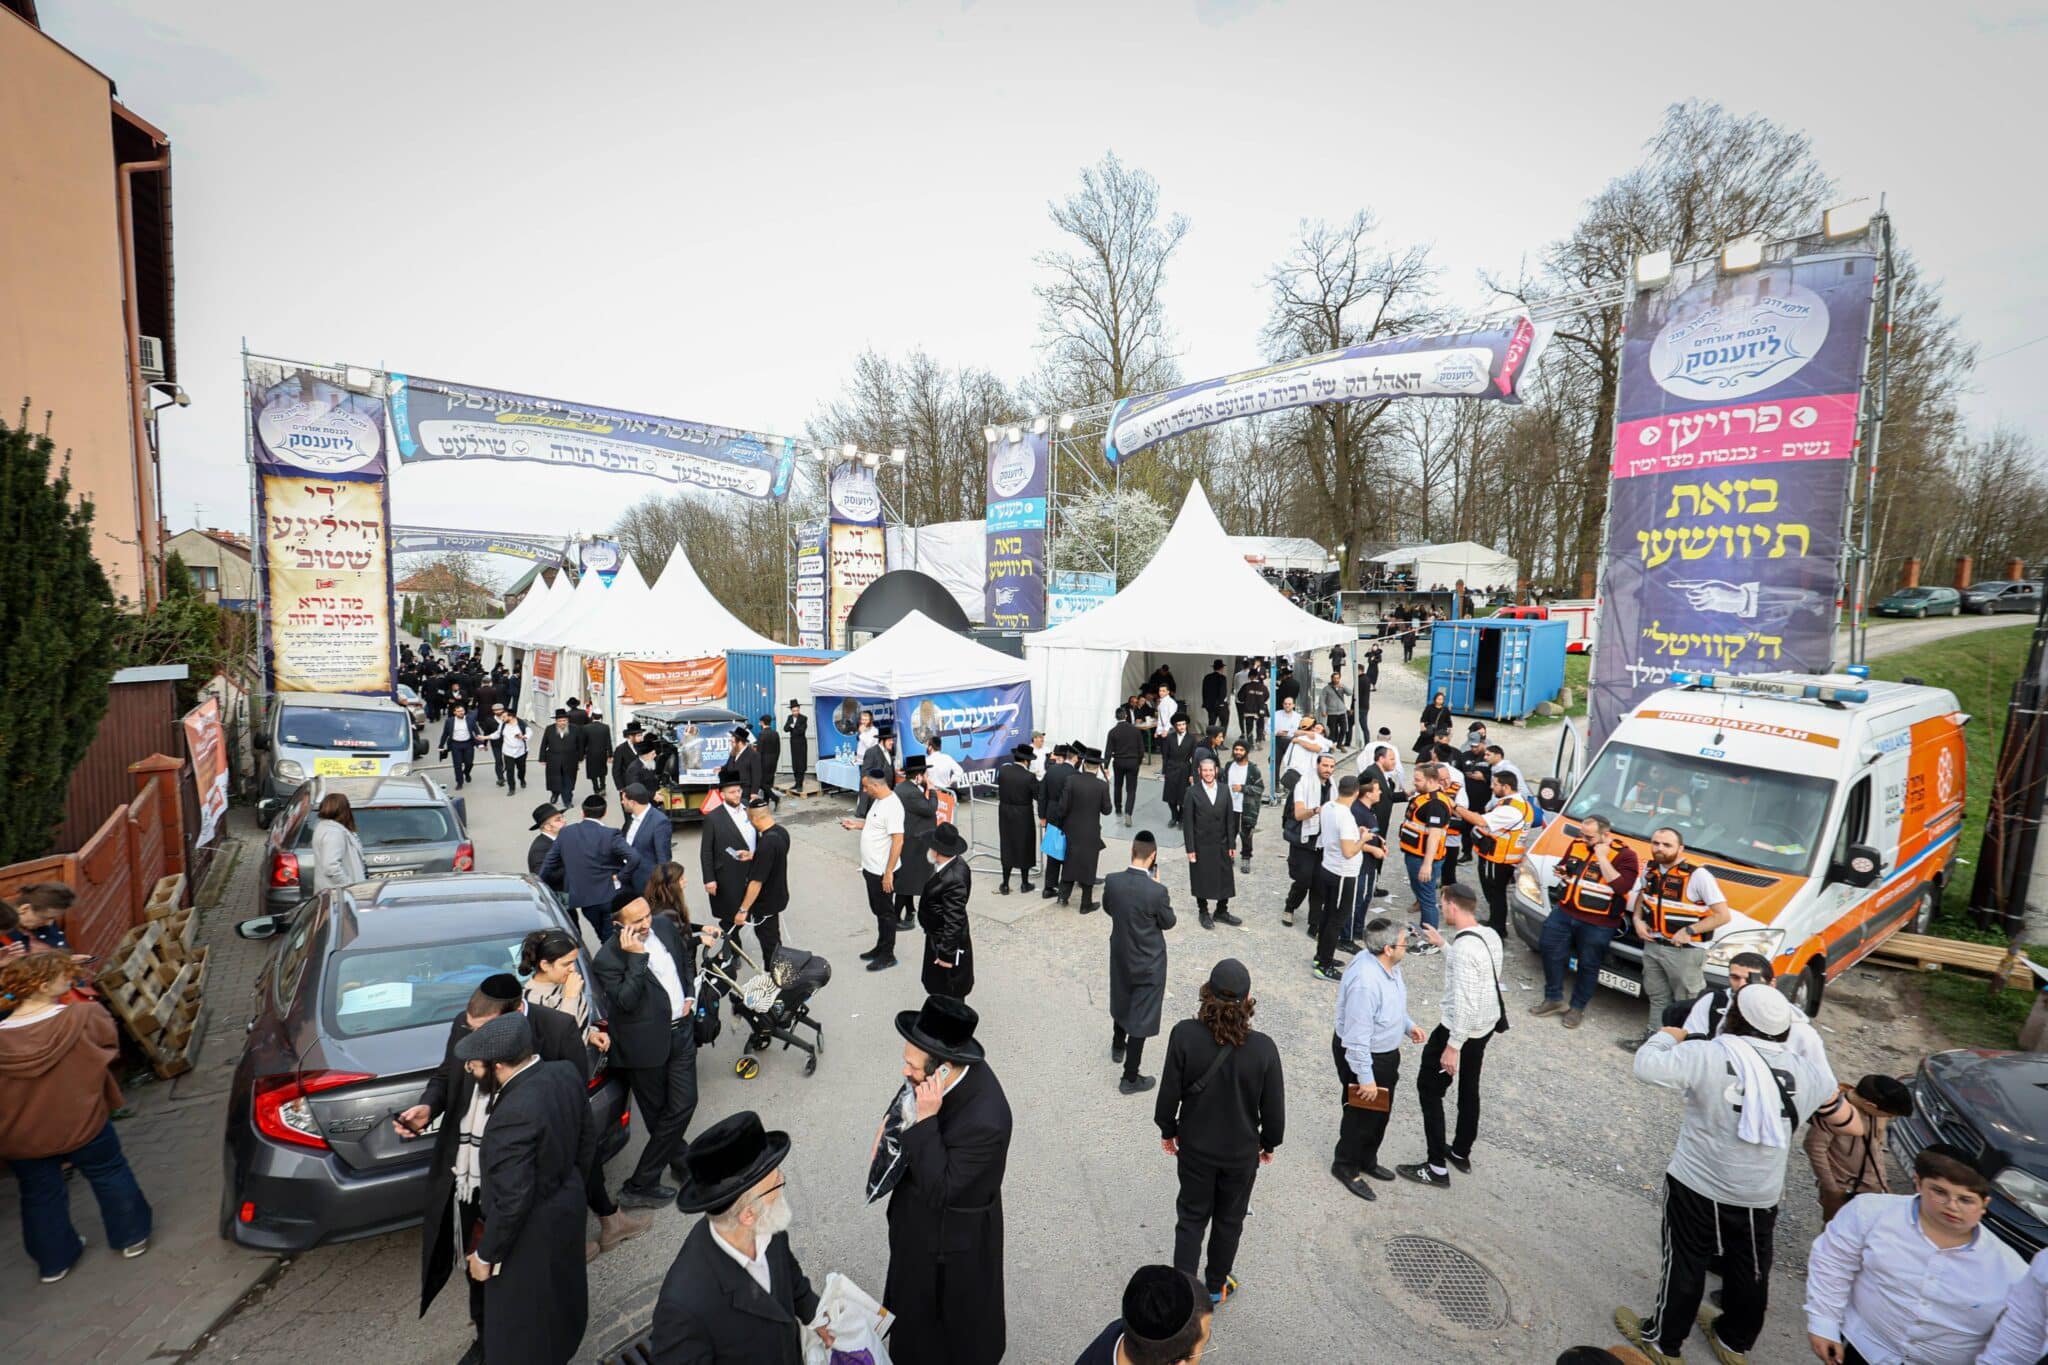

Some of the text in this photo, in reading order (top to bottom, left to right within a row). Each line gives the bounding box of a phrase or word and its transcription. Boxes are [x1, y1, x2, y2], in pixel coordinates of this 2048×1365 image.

[1694, 325, 1777, 347] הכנסת אורחים
[1685, 335, 1782, 373] ליזענסק
[566, 408, 649, 433] אורחים
[1668, 405, 1783, 454] פרויען
[288, 433, 353, 450] ליזענסק
[652, 422, 721, 446] הכנסת
[438, 434, 507, 459] טוילעט
[550, 443, 595, 463] תורה
[1698, 446, 1758, 465] נכנסות
[1781, 441, 1831, 457] נשים
[600, 448, 639, 469] היכל
[1629, 457, 1658, 477] ימין
[1660, 453, 1694, 467] מצד
[671, 464, 742, 487] שטיבלעך
[1665, 478, 1779, 518] בזאת
[1636, 523, 1810, 568] תיוושעו
[298, 597, 364, 610] מה נורא
[288, 614, 375, 631] המקום הזה
[1658, 711, 1809, 740] UNITED HATZALAH
